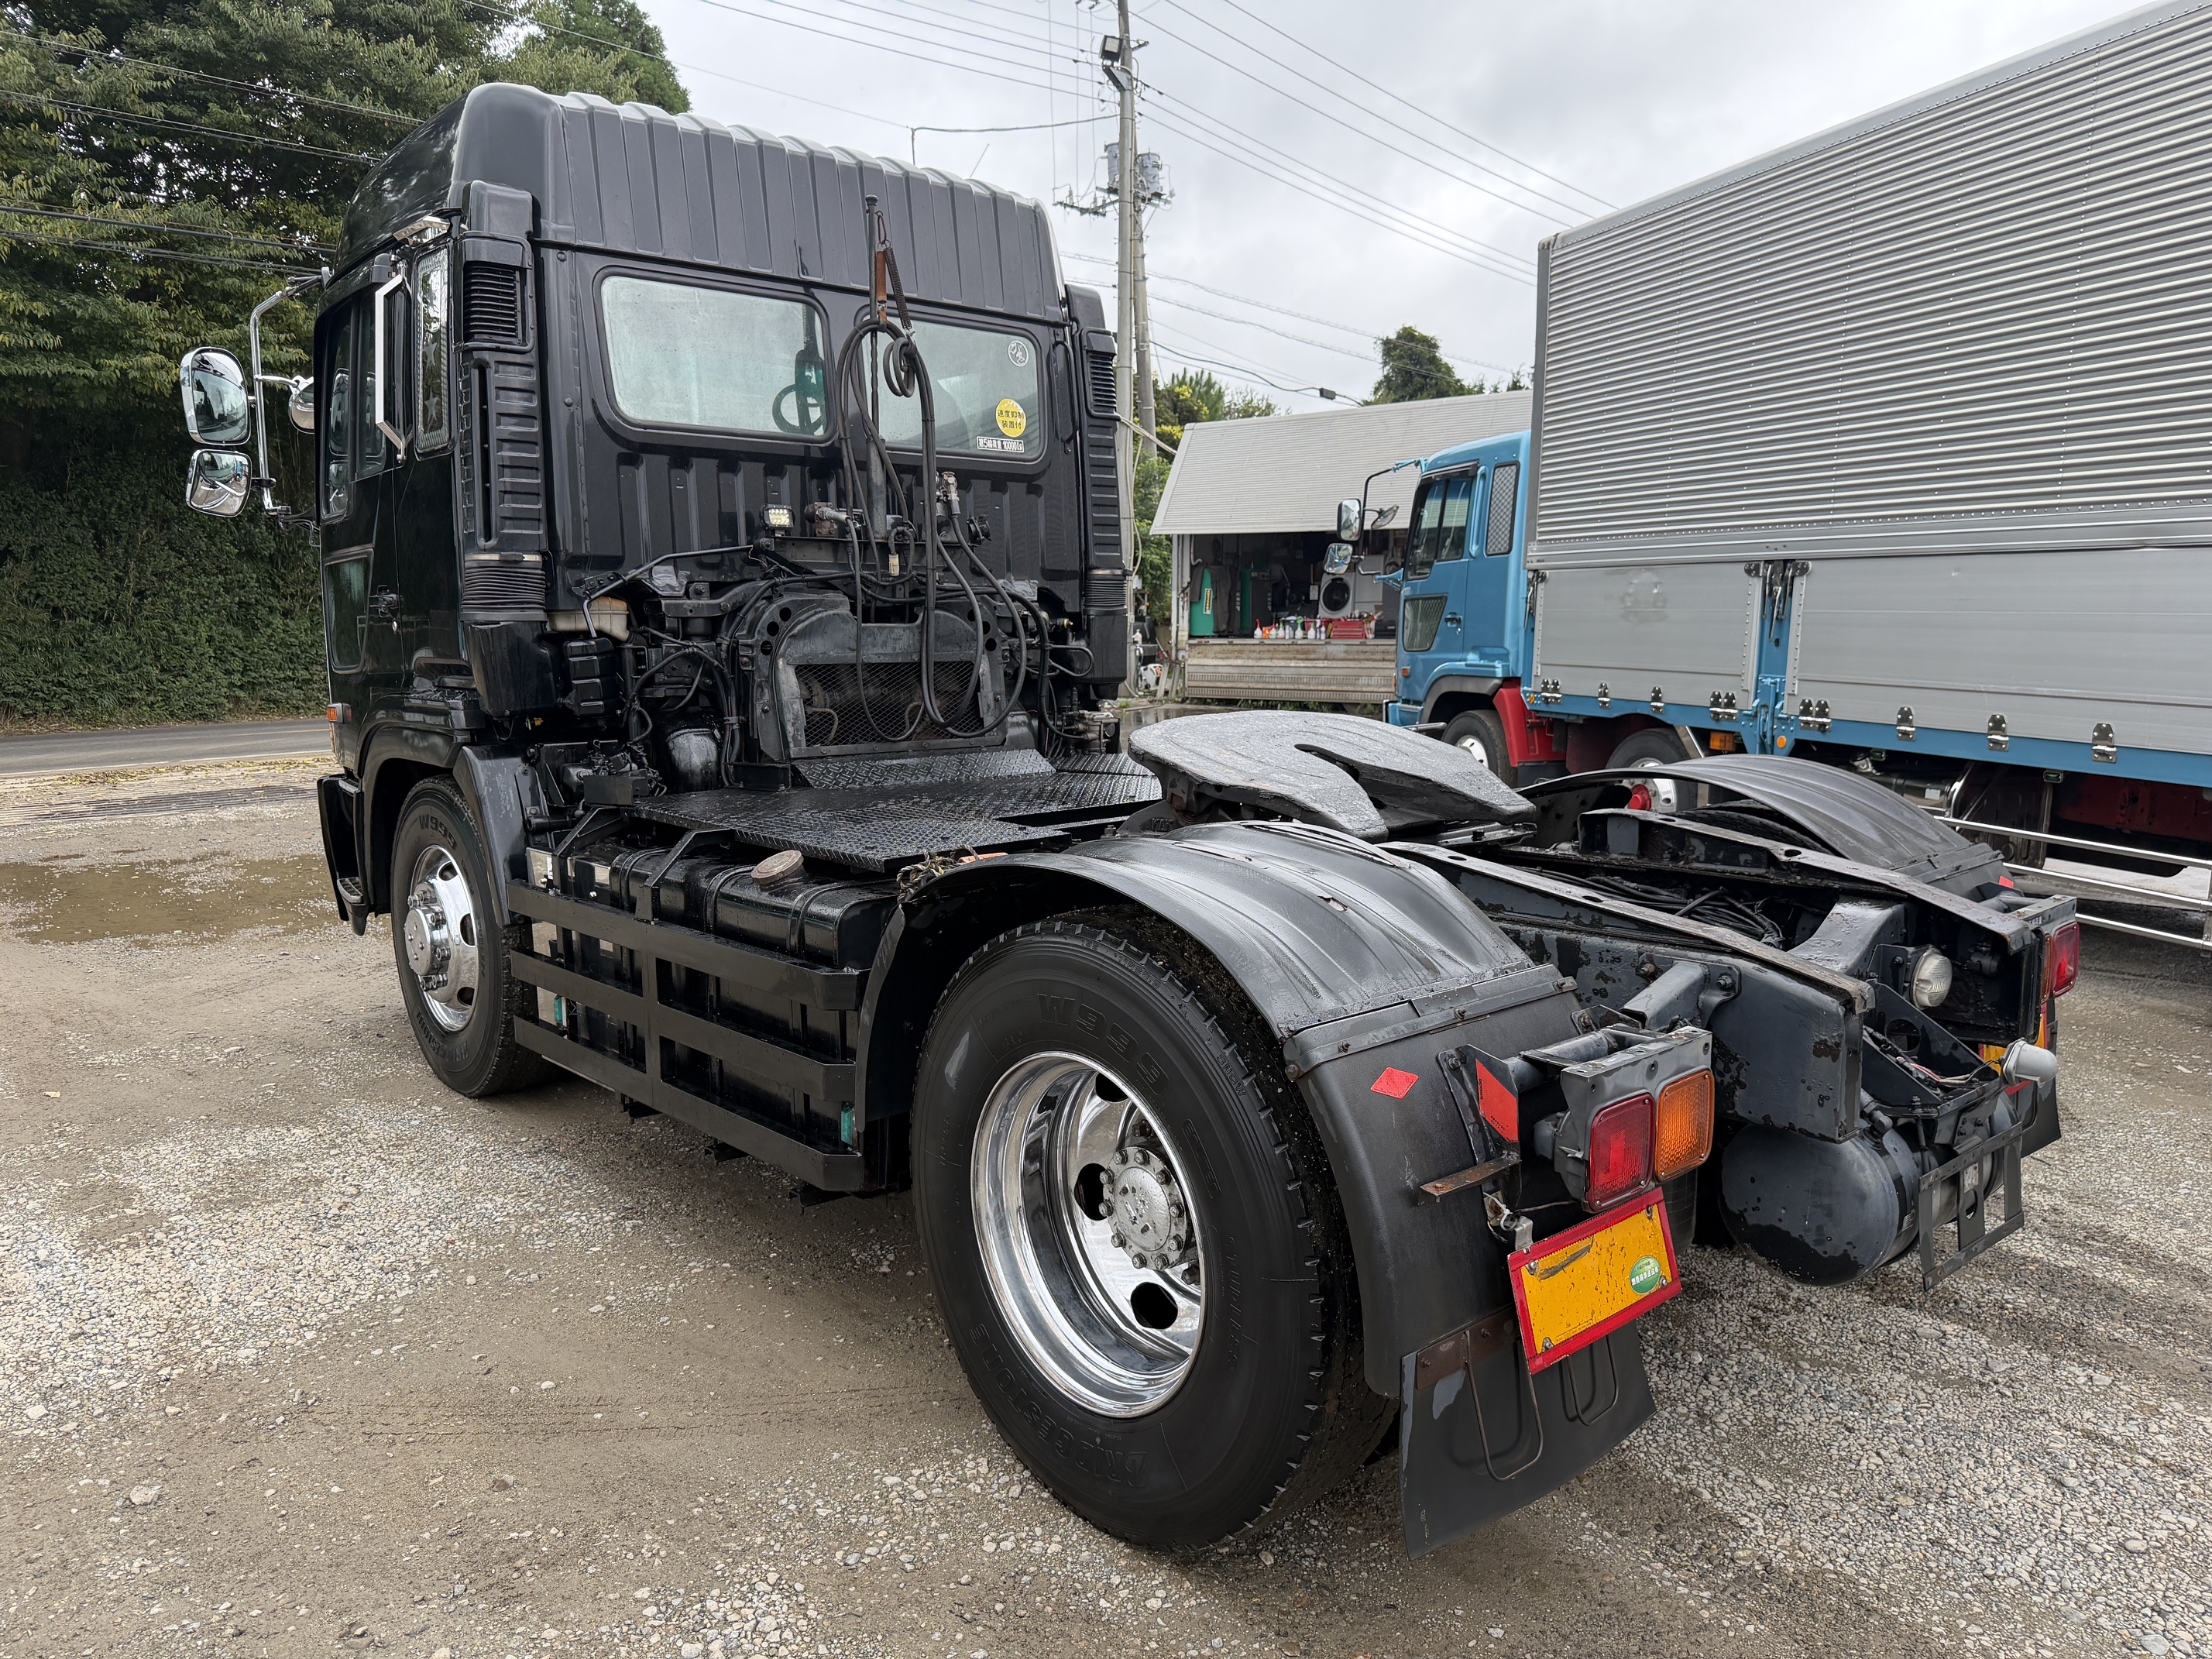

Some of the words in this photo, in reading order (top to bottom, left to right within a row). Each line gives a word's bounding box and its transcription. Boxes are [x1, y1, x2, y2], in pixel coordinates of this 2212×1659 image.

[997, 410, 1025, 420] 速度抑制
[1001, 421, 1022, 430] 装置付
[418, 814, 457, 851] W999
[1036, 993, 1170, 1097] W999
[1215, 1053, 1247, 1097] SNOW
[969, 1323, 1147, 1487] BRIDGESTONE
